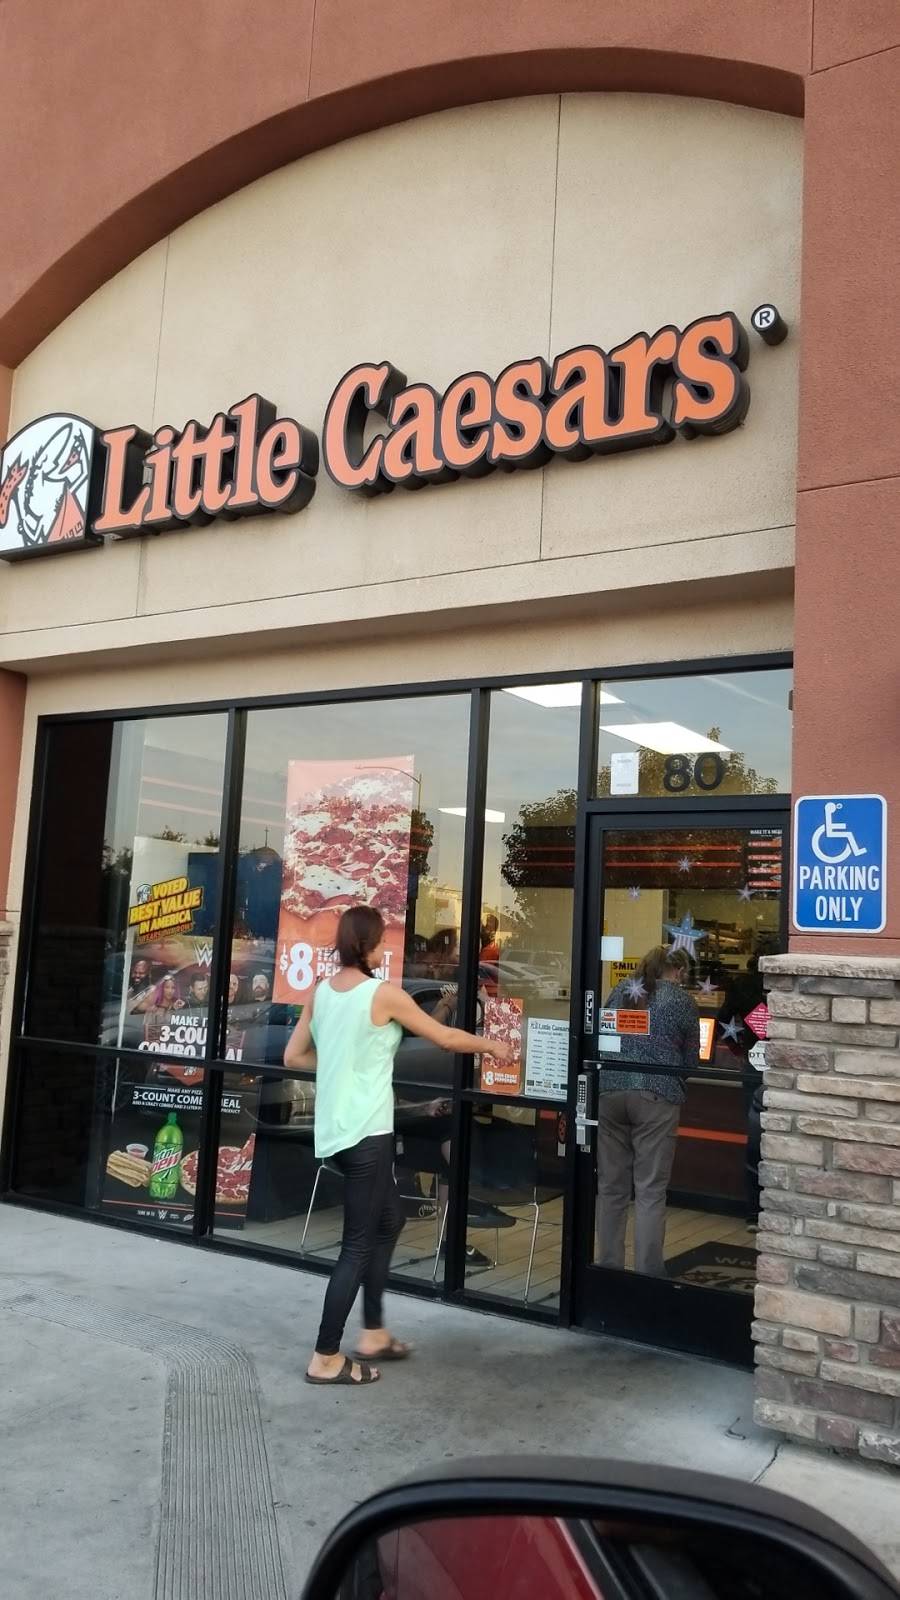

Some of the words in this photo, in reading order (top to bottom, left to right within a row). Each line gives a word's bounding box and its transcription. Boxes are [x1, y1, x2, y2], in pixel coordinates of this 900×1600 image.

[93, 393, 309, 533] Little
[323, 311, 744, 488] Caesars
[663, 752, 724, 792] 80
[152, 879, 188, 900] VOTED
[799, 866, 880, 891] PARKING
[130, 902, 160, 924] BEST
[160, 889, 202, 916] VALUE
[815, 895, 863, 921] ONLY
[139, 920, 151, 935] IN
[150, 909, 191, 932] AMERICA
[279, 943, 313, 991] $8
[612, 961, 637, 971] SMIL
[171, 1014, 199, 1027] MAKE
[586, 994, 594, 1024] PULL
[159, 1025, 208, 1045] 3-COU
[601, 1022, 617, 1030] PULL
[133, 1091, 175, 1103] 3-COUNT
